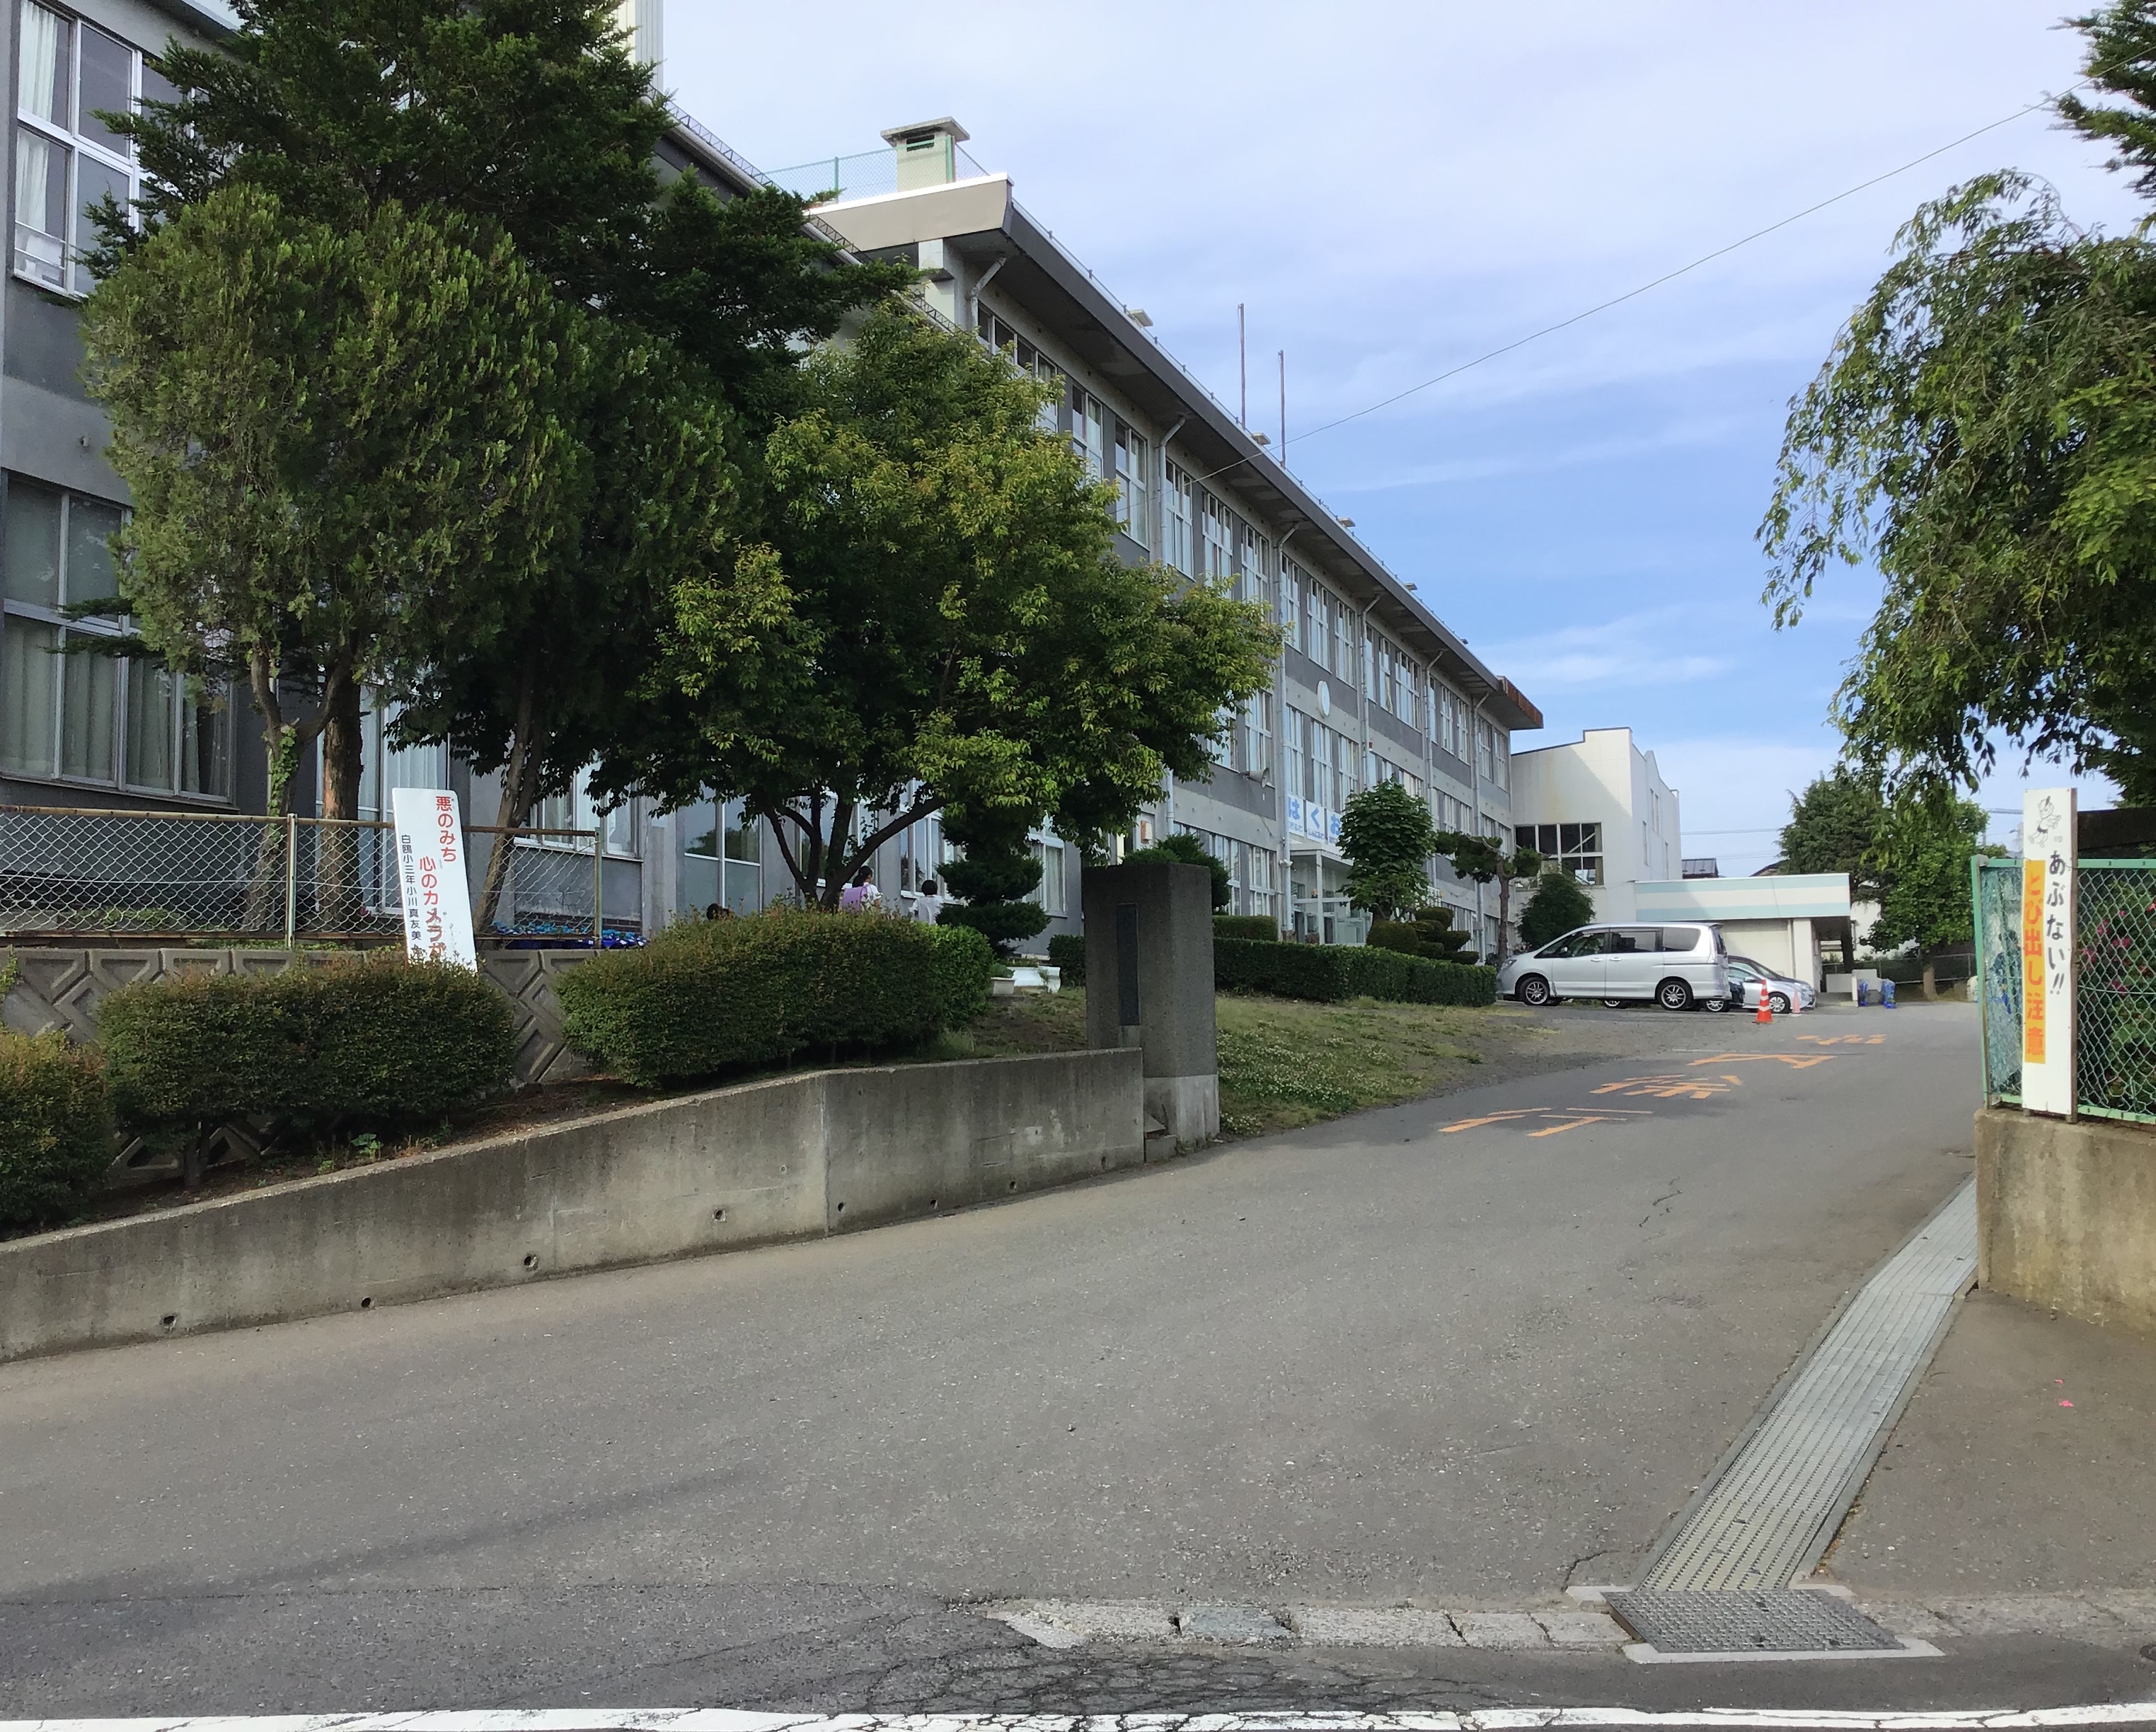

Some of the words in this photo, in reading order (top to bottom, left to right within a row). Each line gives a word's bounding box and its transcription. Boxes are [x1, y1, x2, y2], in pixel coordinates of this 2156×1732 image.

[436, 796, 456, 862] 悪のみち
[2024, 873, 2043, 1056] とび出し注意
